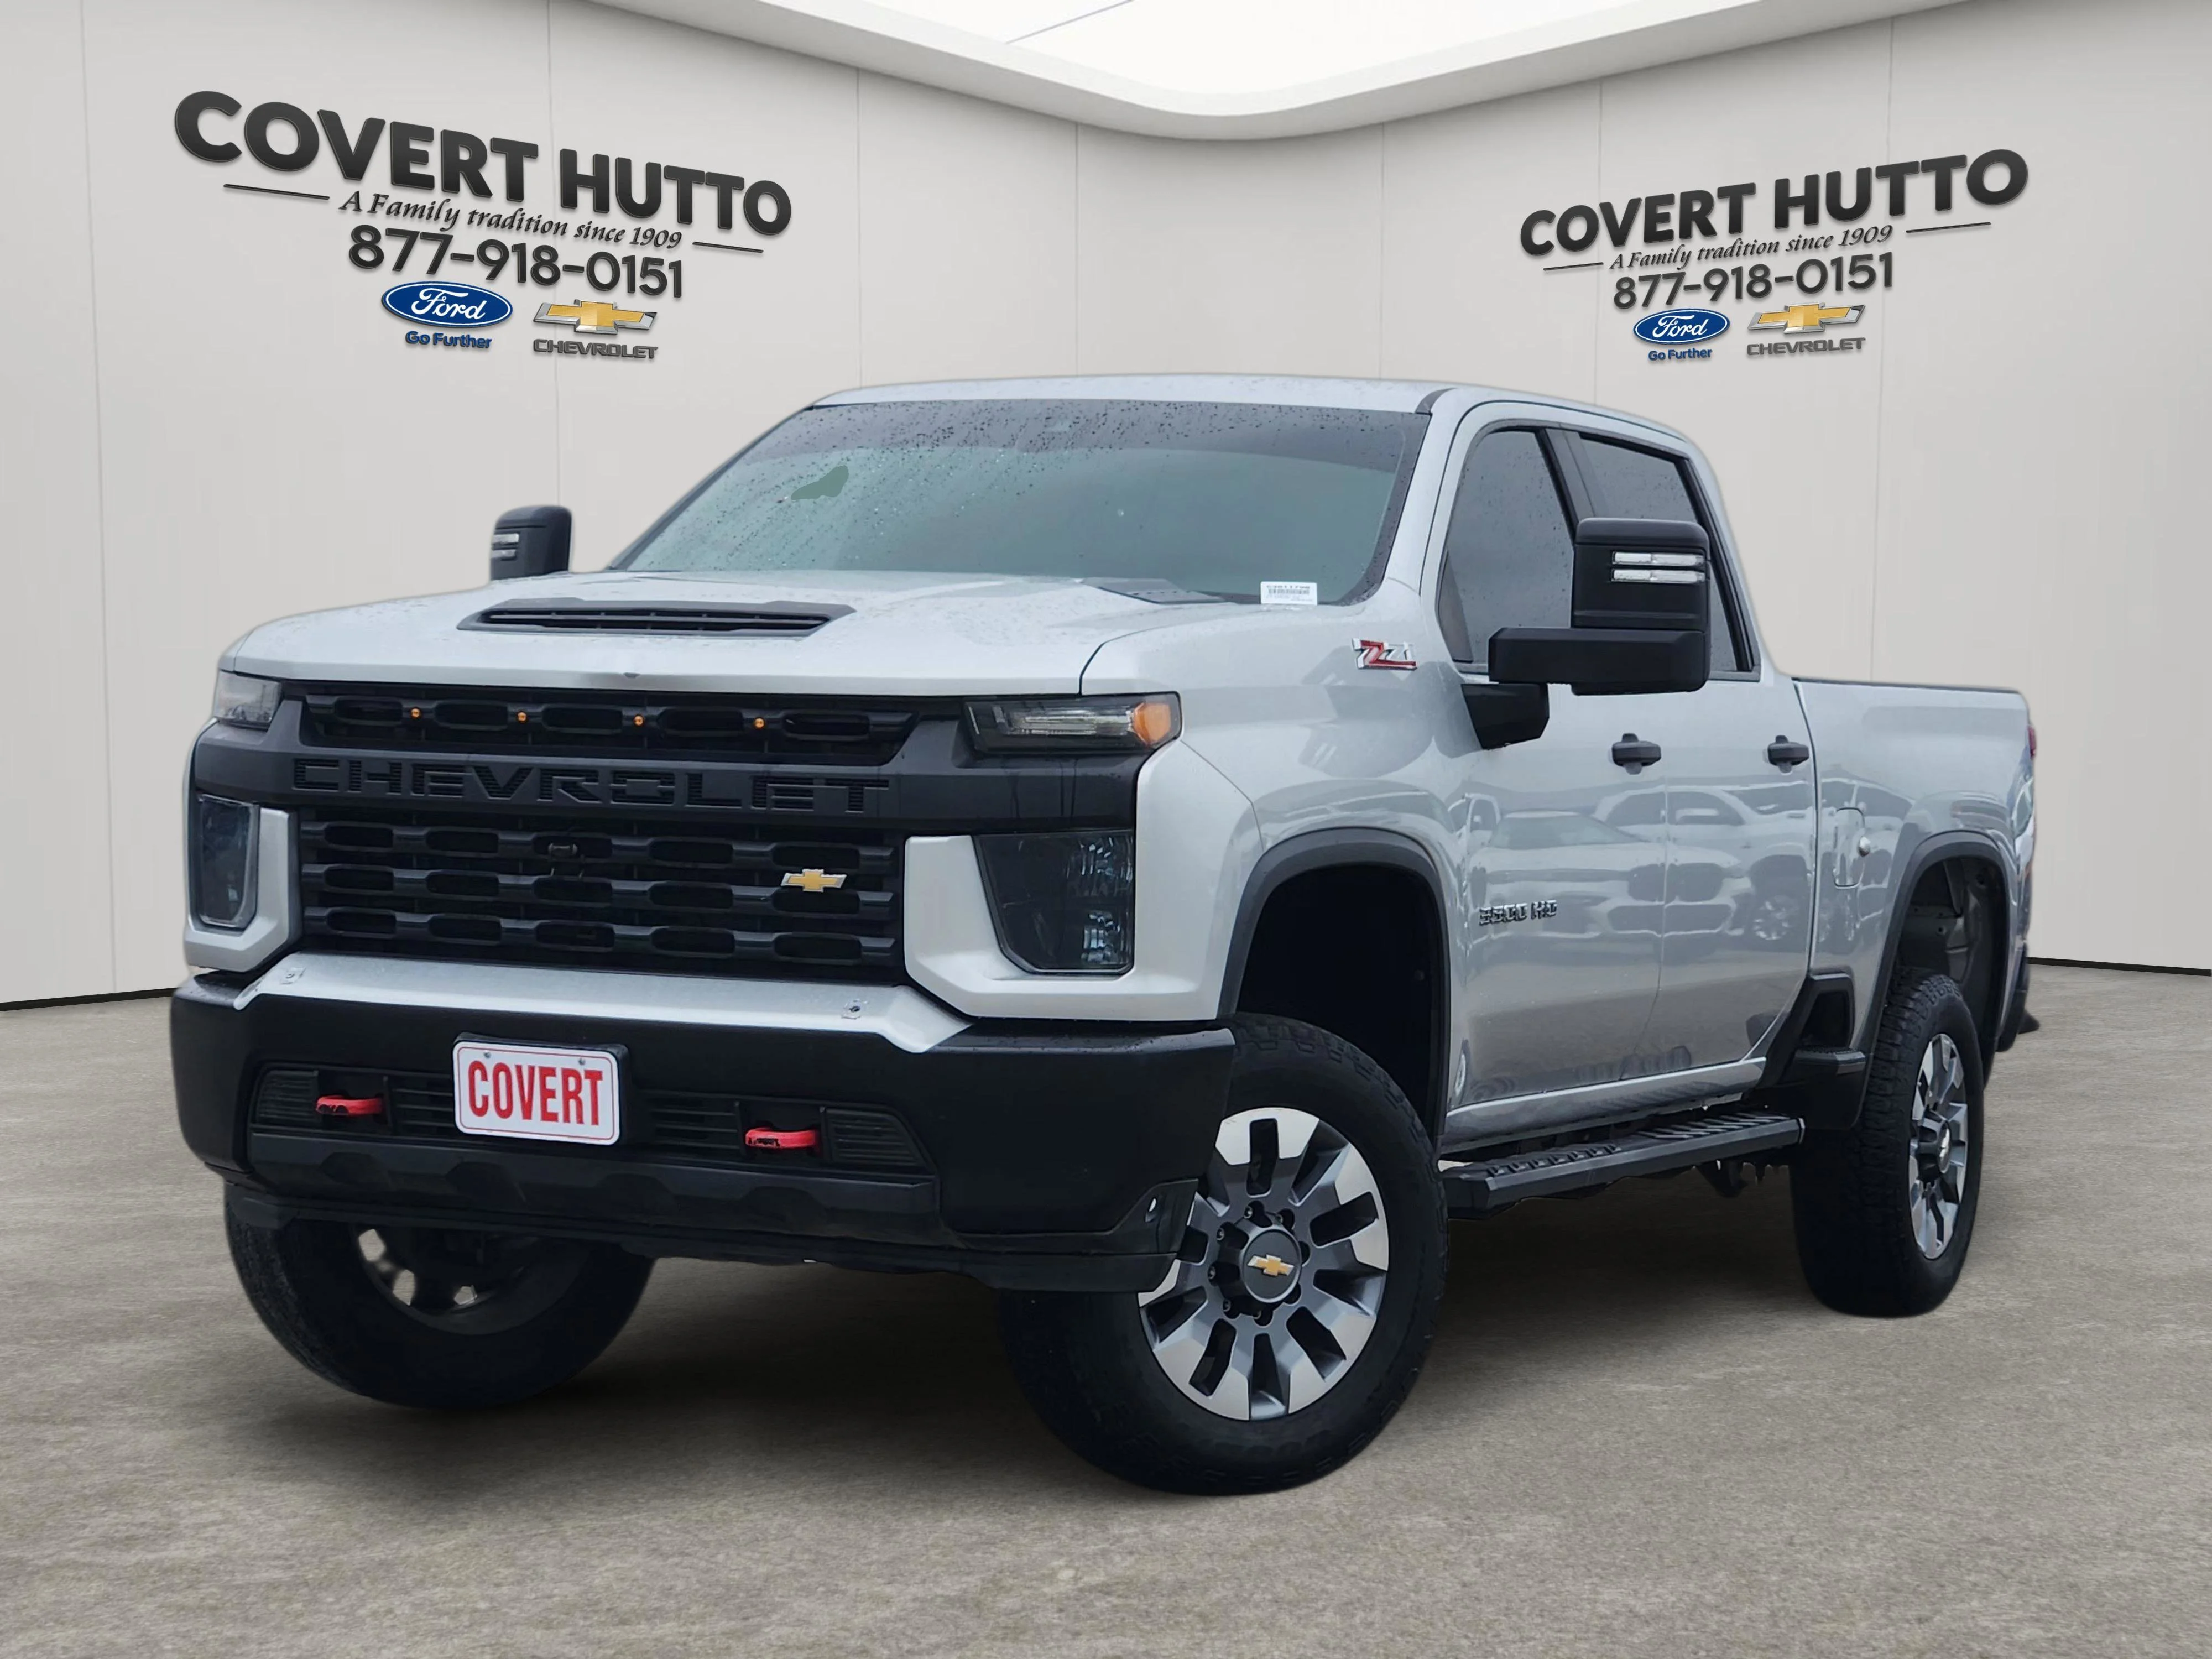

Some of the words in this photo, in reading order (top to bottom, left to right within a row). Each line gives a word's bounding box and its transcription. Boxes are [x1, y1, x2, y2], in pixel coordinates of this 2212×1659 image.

[173, 90, 540, 204] COVERT
[559, 148, 792, 237] HUTTO
[338, 190, 362, 212] A
[367, 192, 461, 232] Family
[467, 207, 568, 237] tradition
[573, 221, 626, 243] since
[629, 226, 682, 249] 1909
[1520, 182, 1757, 257] COVERT
[1773, 148, 2029, 231] HUTTO
[348, 223, 682, 299] 877-918-0151
[1609, 253, 1624, 270] A
[1626, 243, 1692, 271] Family
[1697, 237, 1780, 262] tradition
[1785, 232, 1834, 252] since
[1838, 225, 1893, 247] 1909
[1613, 251, 1893, 310] 877-918-0151
[411, 288, 488, 320] Ford
[405, 331, 431, 346] Go
[432, 332, 492, 349] Further
[1651, 314, 1708, 338] Ford
[533, 338, 659, 359] CHEVROLET
[1648, 350, 1666, 361] Go
[1668, 348, 1713, 361] Further
[1746, 337, 1866, 356] CHEVROLET
[1352, 638, 1418, 671] Z71
[292, 758, 890, 814] CHEVROLET
[1530, 899, 1558, 920] HD
[468, 1060, 603, 1126] COVERT
